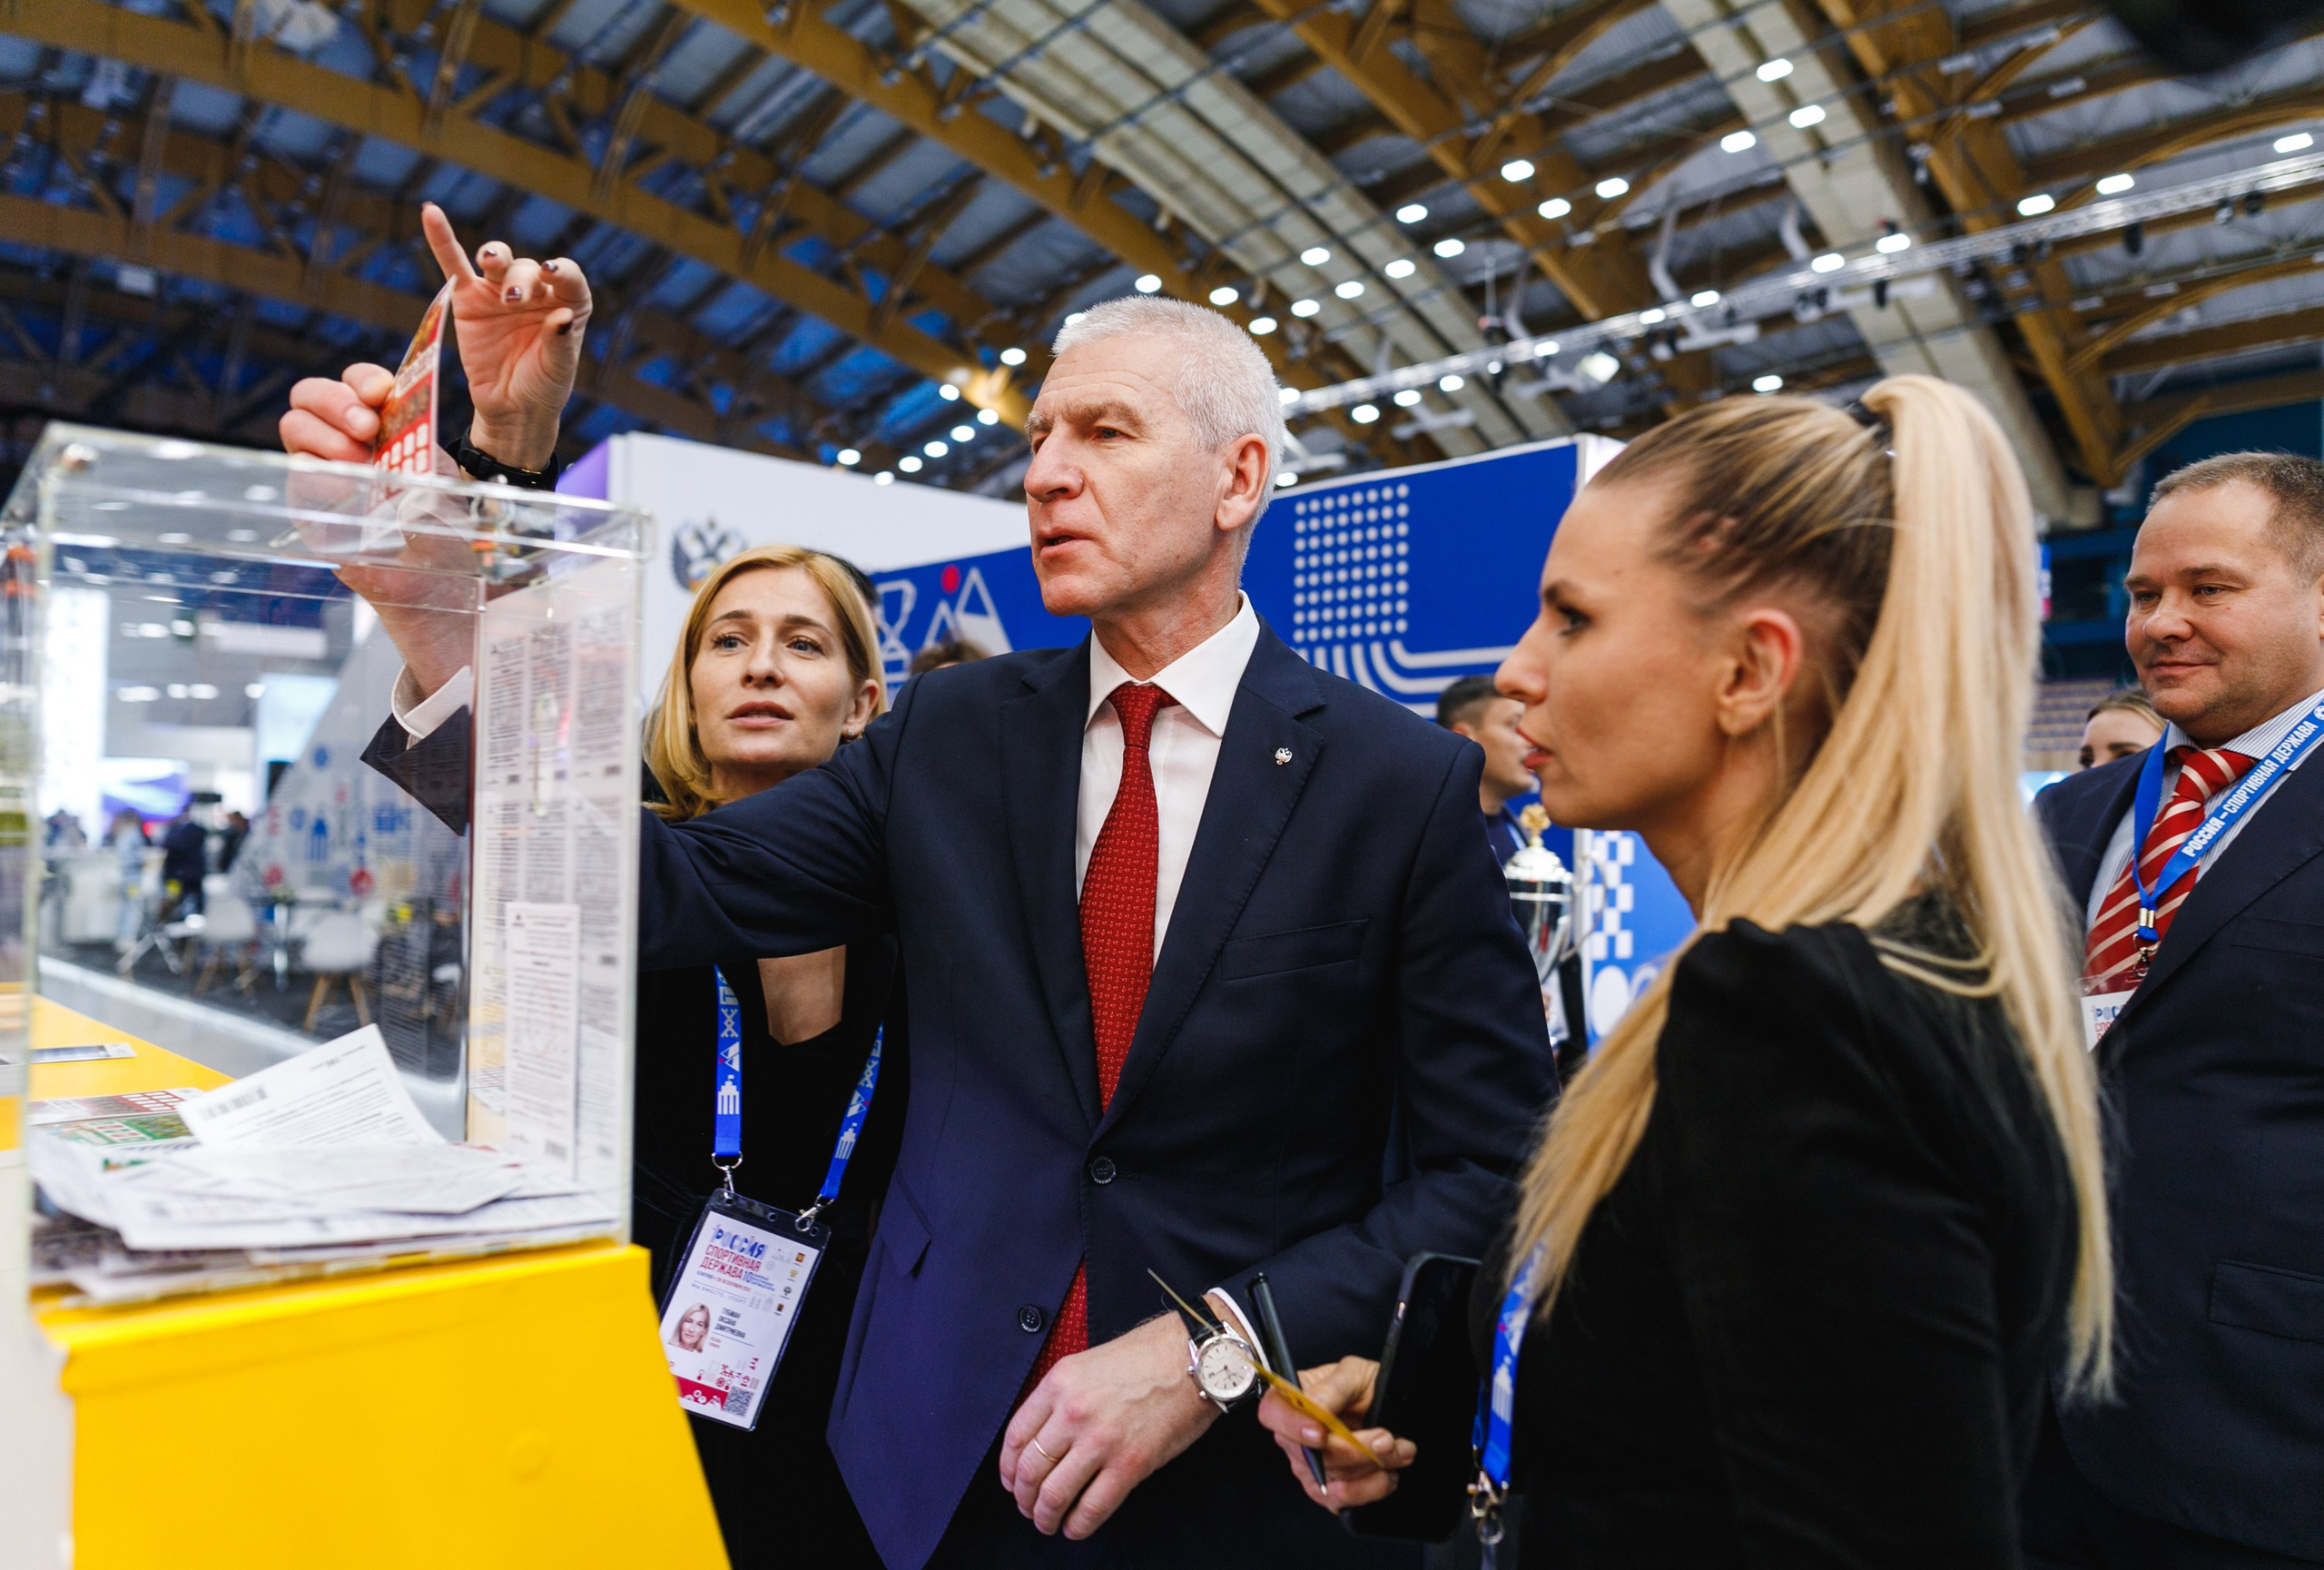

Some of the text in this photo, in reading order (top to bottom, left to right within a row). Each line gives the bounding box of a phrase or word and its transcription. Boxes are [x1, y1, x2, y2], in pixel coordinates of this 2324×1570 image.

[2181, 816, 2226, 857] РОССИЯ
[2222, 759, 2280, 815] СПОРТИВНАЯ
[2270, 720, 2319, 765] ДЕРЖАВА
[2093, 1005, 2125, 1022] РОС
[705, 1244, 762, 1272] СПОРТИВНАЯ
[710, 1229, 768, 1260] РОССИЯ
[700, 1256, 743, 1280] ДЕРЖАВА
